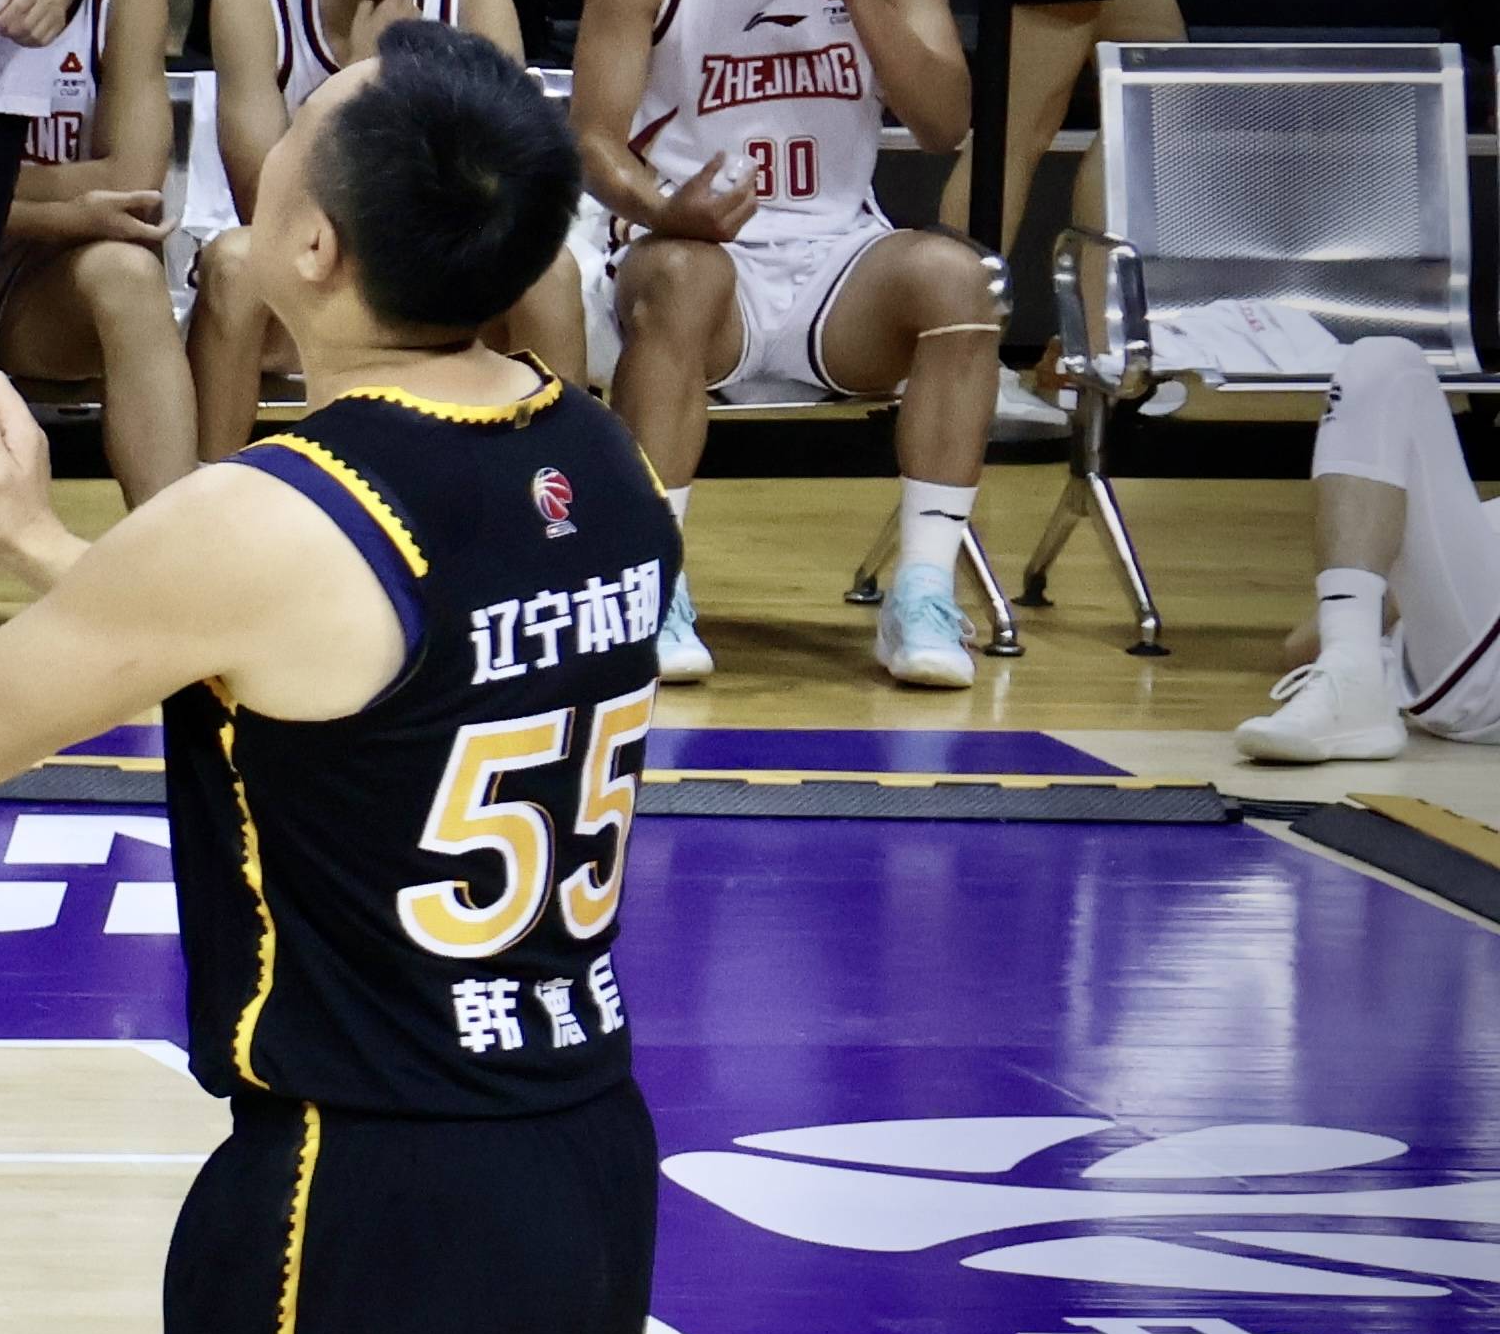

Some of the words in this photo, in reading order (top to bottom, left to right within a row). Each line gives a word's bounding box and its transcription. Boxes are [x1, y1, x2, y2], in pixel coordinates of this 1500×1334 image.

[701, 45, 859, 110] ZHEJIANG
[746, 137, 819, 201] 30
[469, 558, 663, 686] 辽宁本钢
[396, 677, 660, 960] 55
